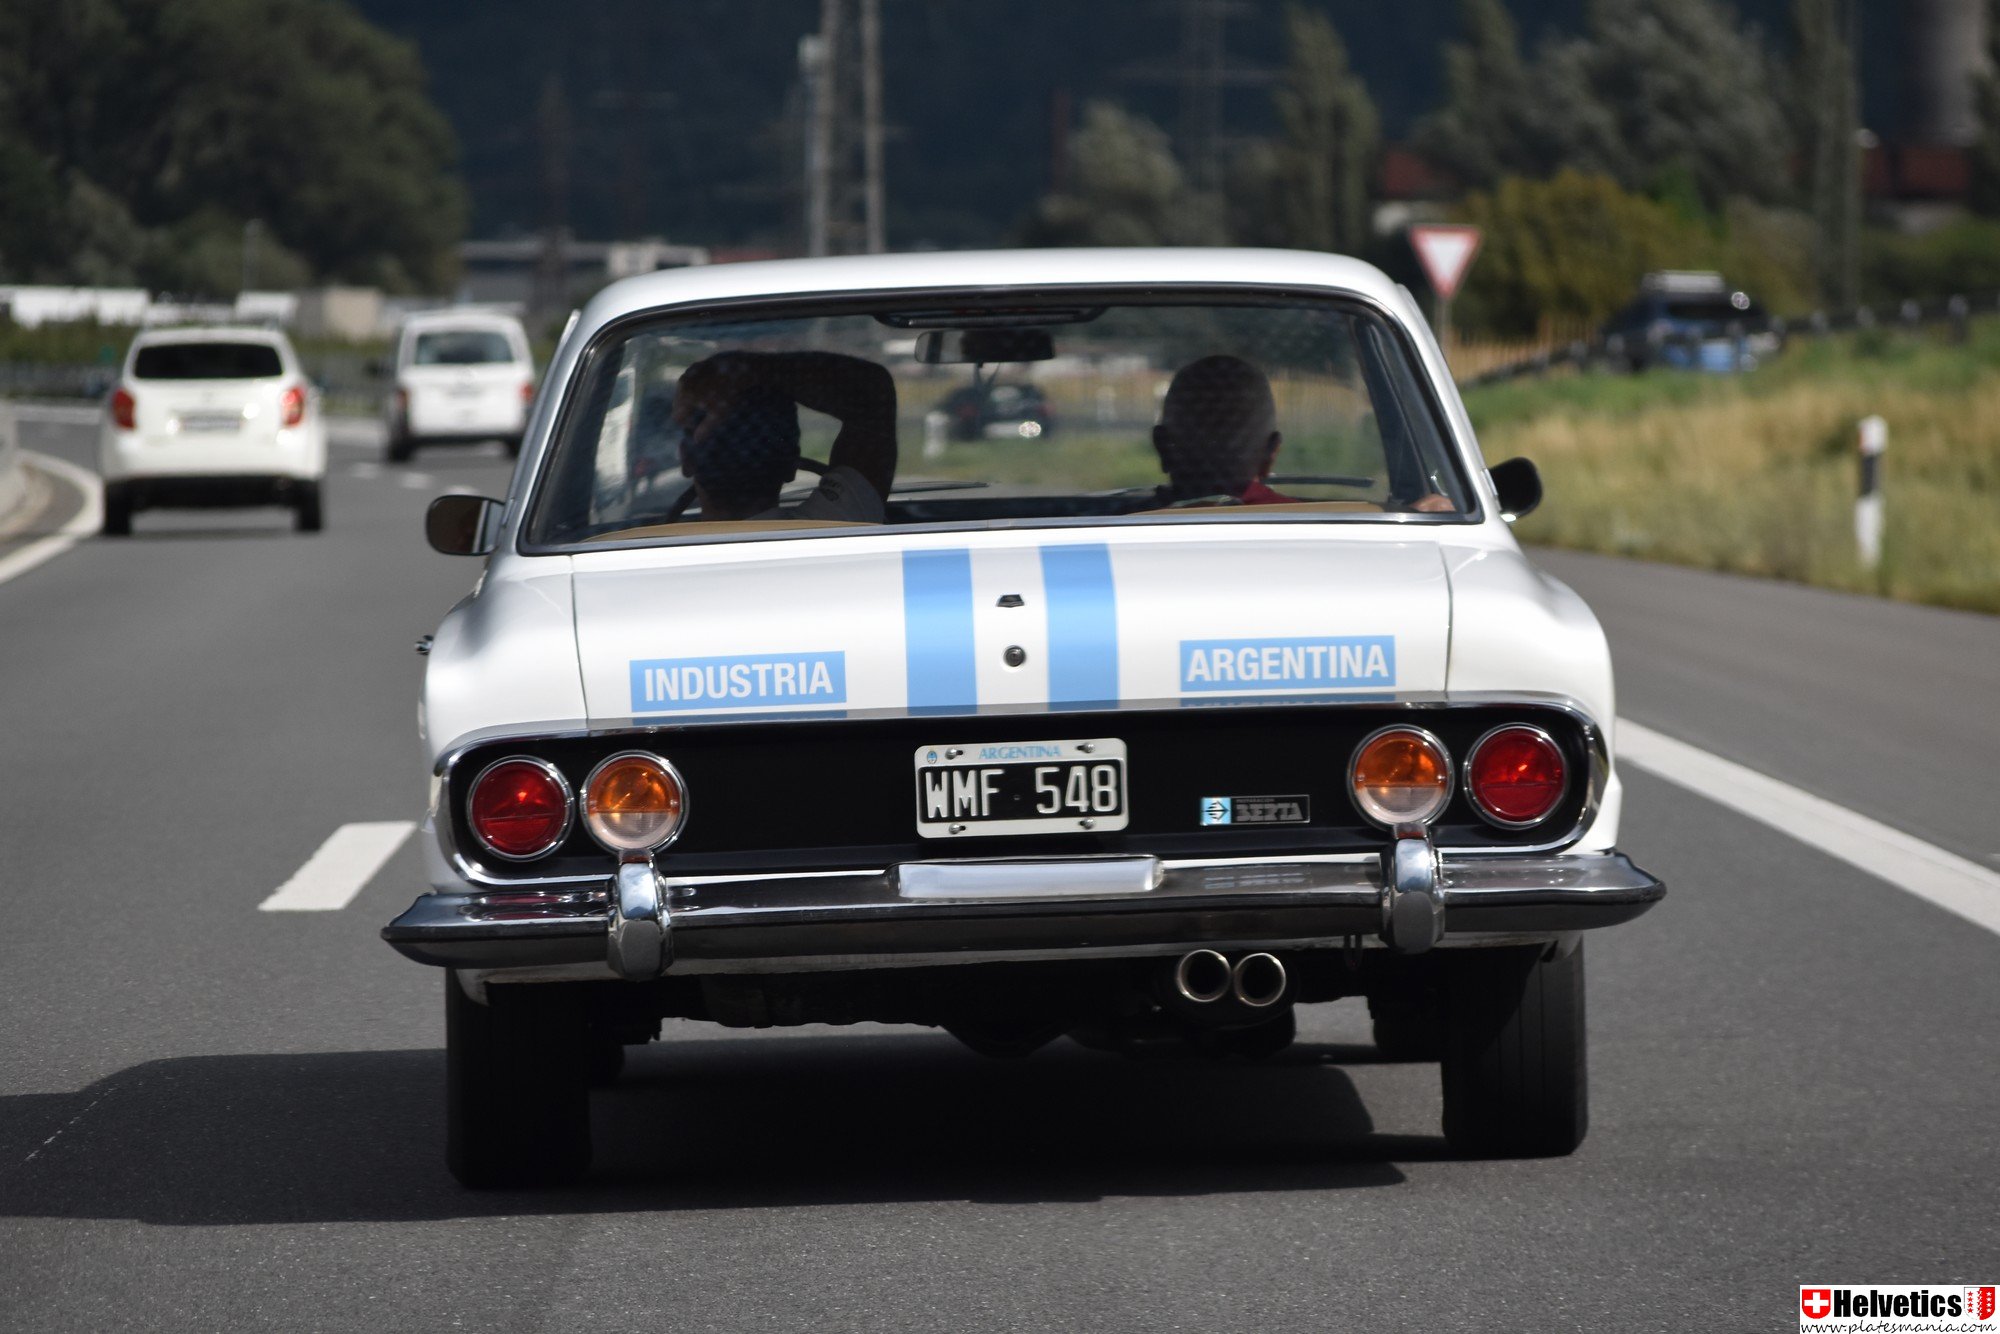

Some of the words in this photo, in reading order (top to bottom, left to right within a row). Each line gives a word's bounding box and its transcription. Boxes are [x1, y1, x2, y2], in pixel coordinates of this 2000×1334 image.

[645, 661, 834, 701] INDUSTRIA
[1187, 644, 1389, 682] ARGENTINA
[978, 745, 1061, 760] ARGENTINA
[925, 769, 1004, 818] WMF
[1035, 765, 1117, 813] 548
